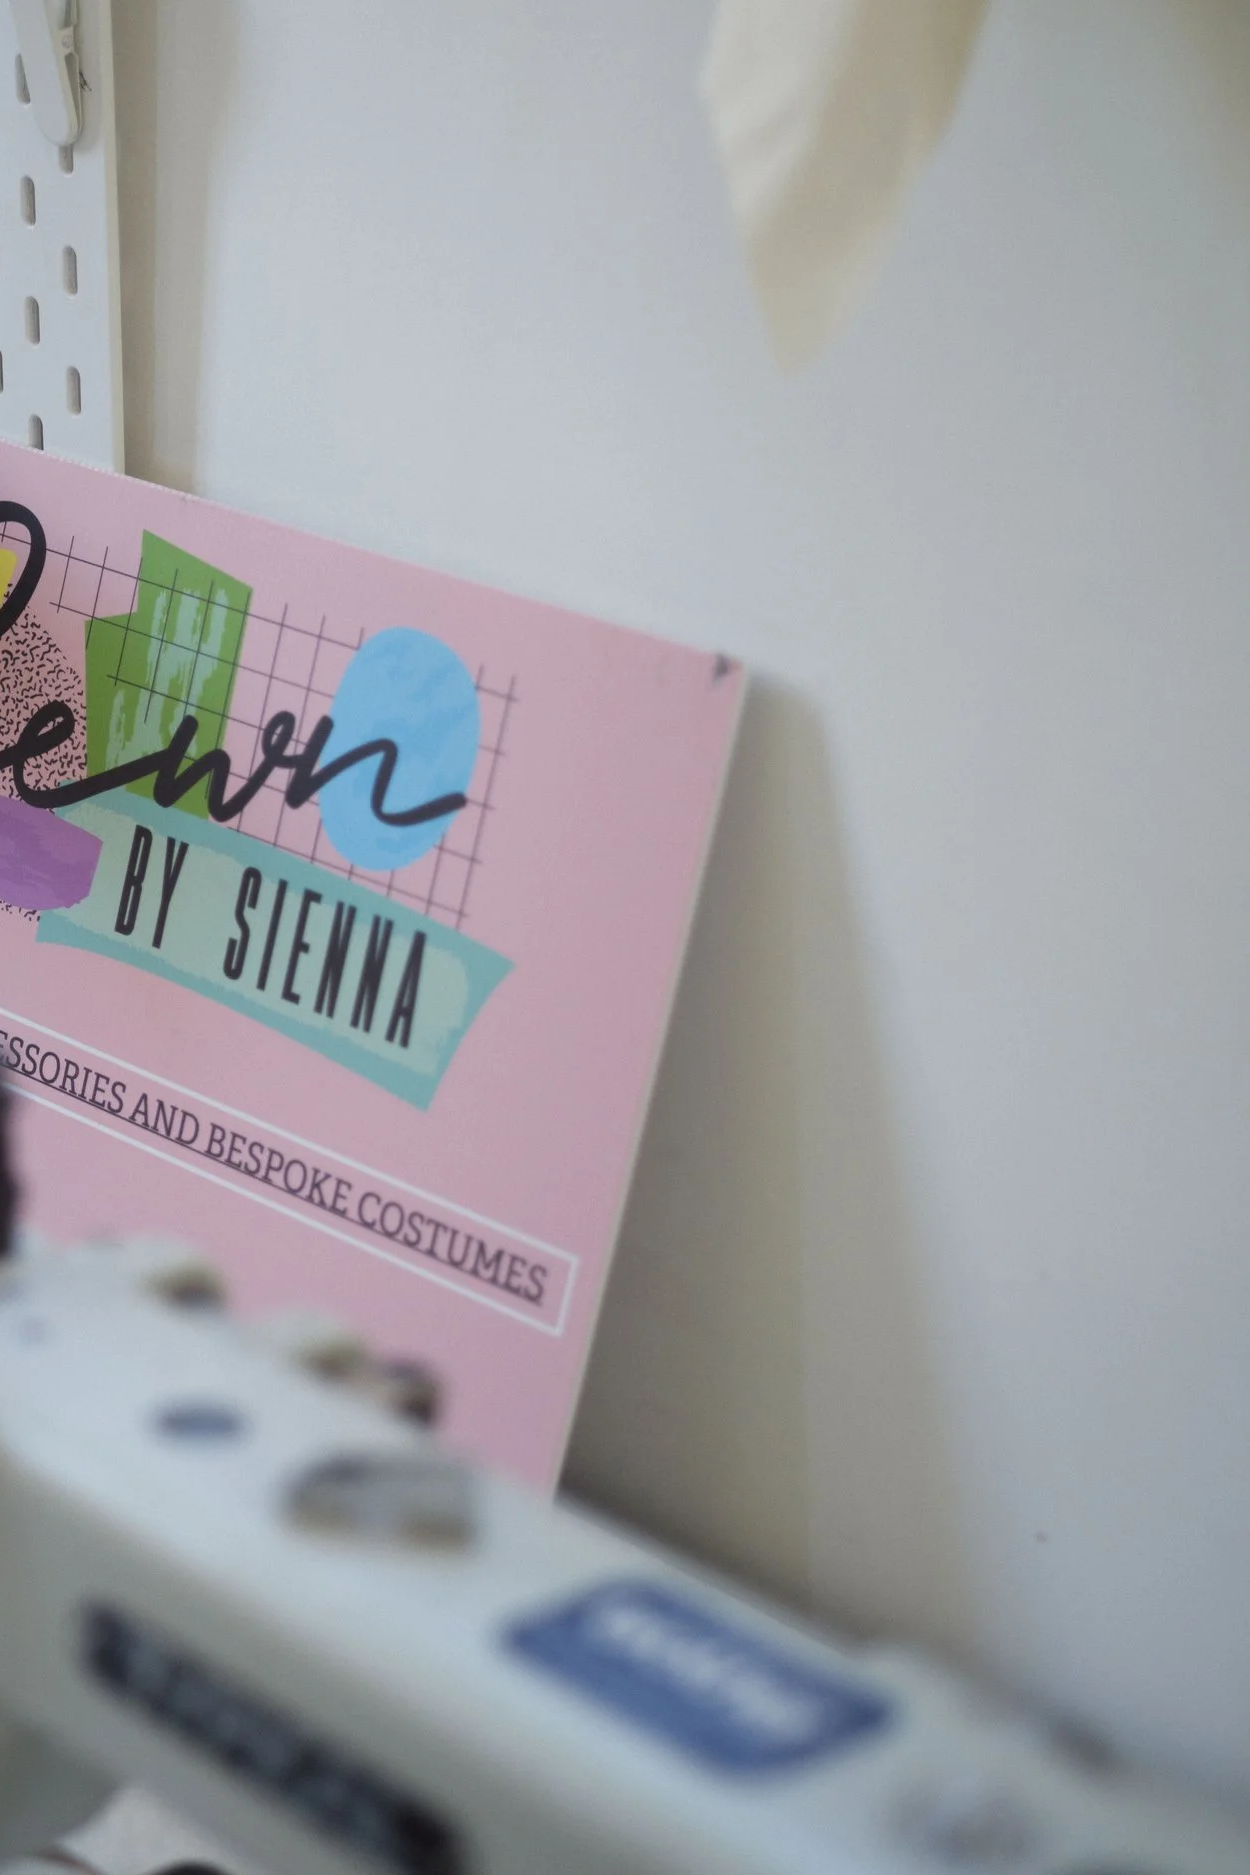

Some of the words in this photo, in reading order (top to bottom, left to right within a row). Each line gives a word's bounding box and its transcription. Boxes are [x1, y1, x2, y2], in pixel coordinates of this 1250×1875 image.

[114, 824, 189, 949] BY
[222, 866, 427, 1049] SIENNA
[128, 1092, 200, 1147] AND
[204, 1122, 354, 1218] BESPOKE
[357, 1191, 549, 1305] COSTUMES
